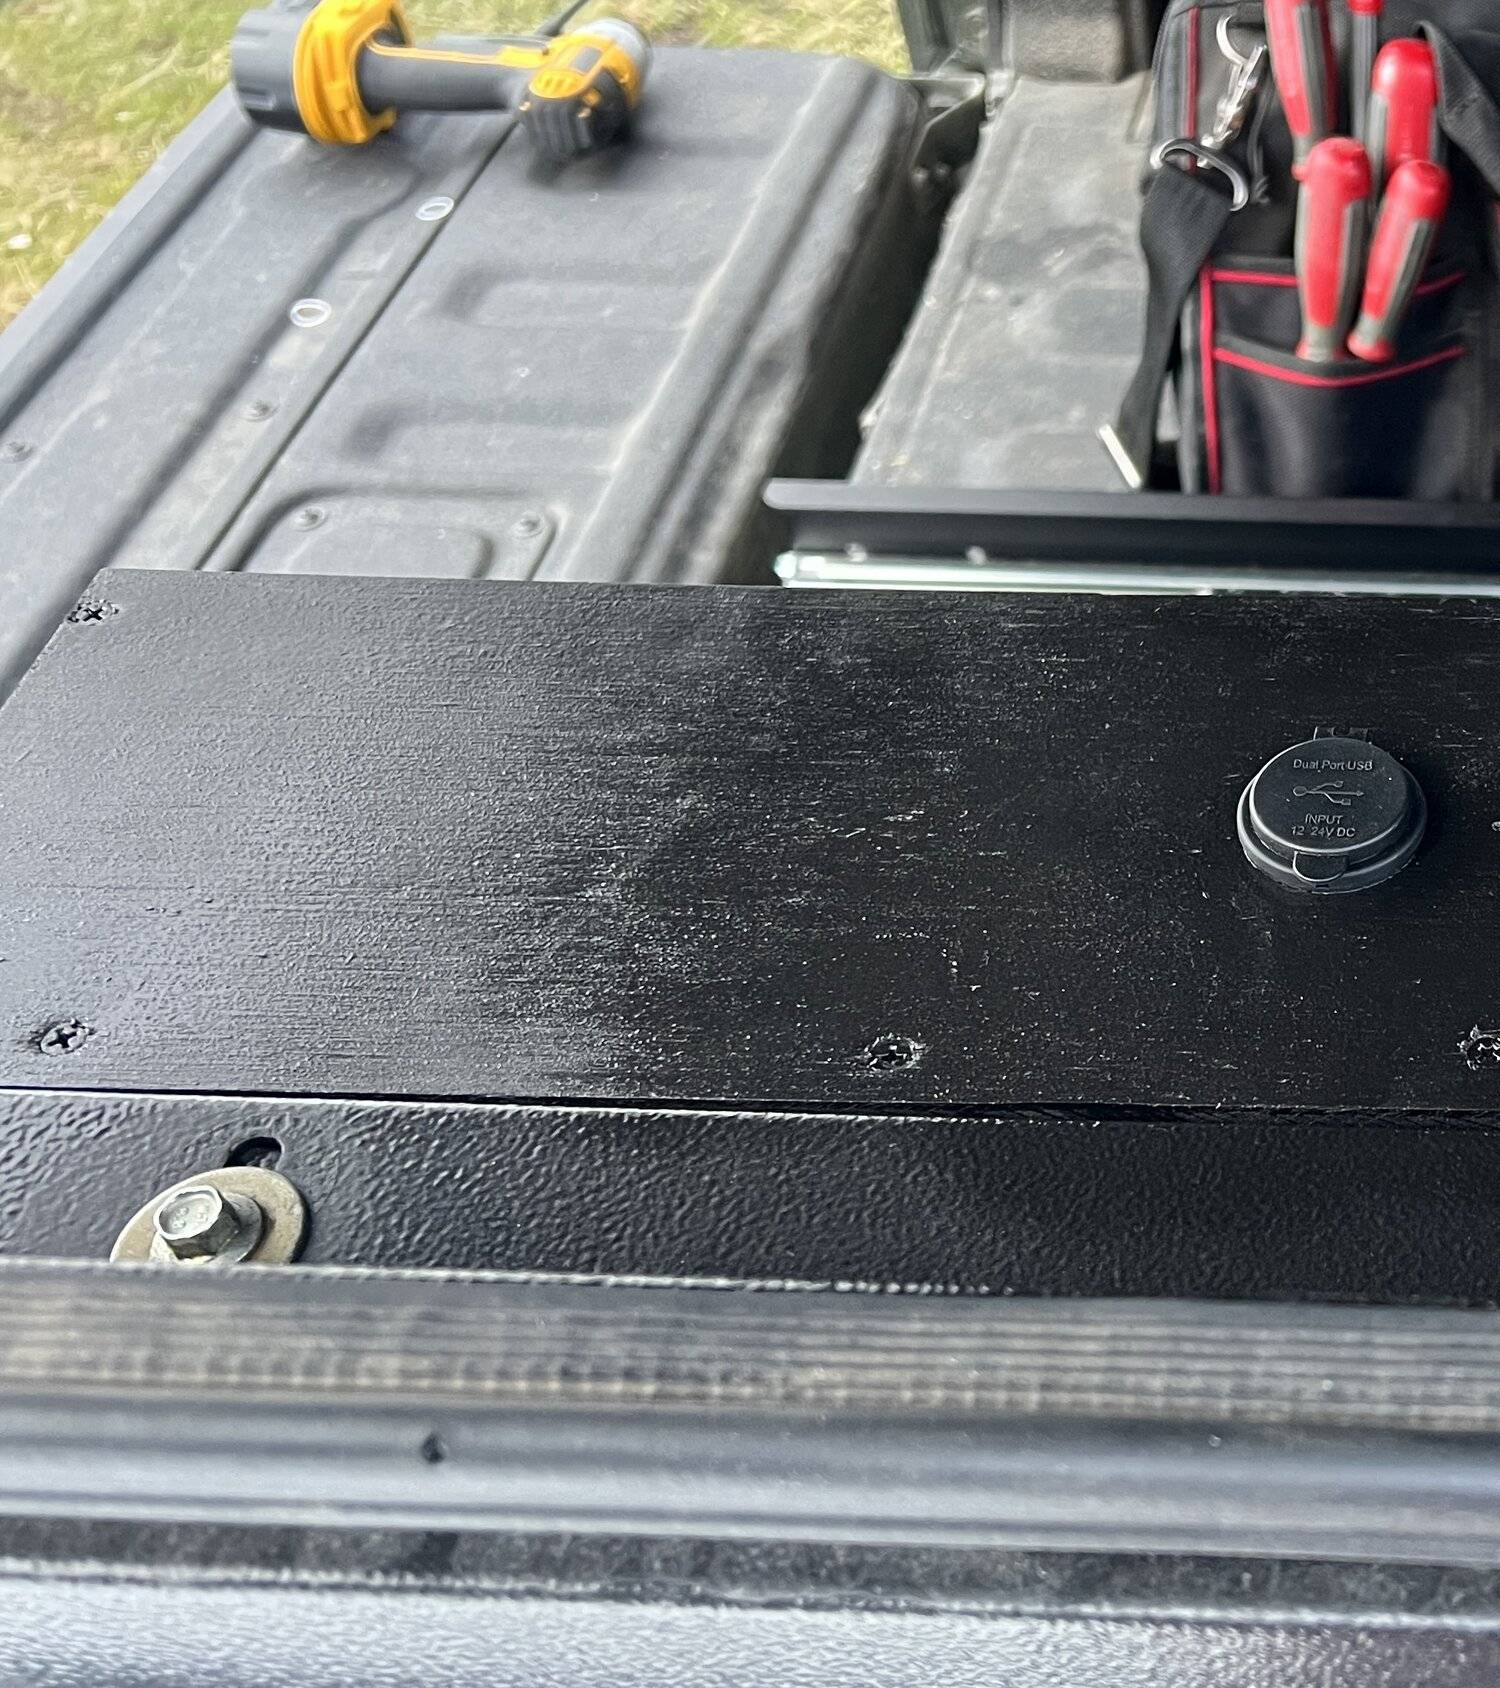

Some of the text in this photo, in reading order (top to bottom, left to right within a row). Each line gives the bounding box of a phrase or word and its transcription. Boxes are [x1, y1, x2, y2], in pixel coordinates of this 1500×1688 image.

[1293, 758, 1373, 772] Dual Port USB
[1304, 812, 1344, 825] INPUT
[1336, 827, 1356, 838] DC
